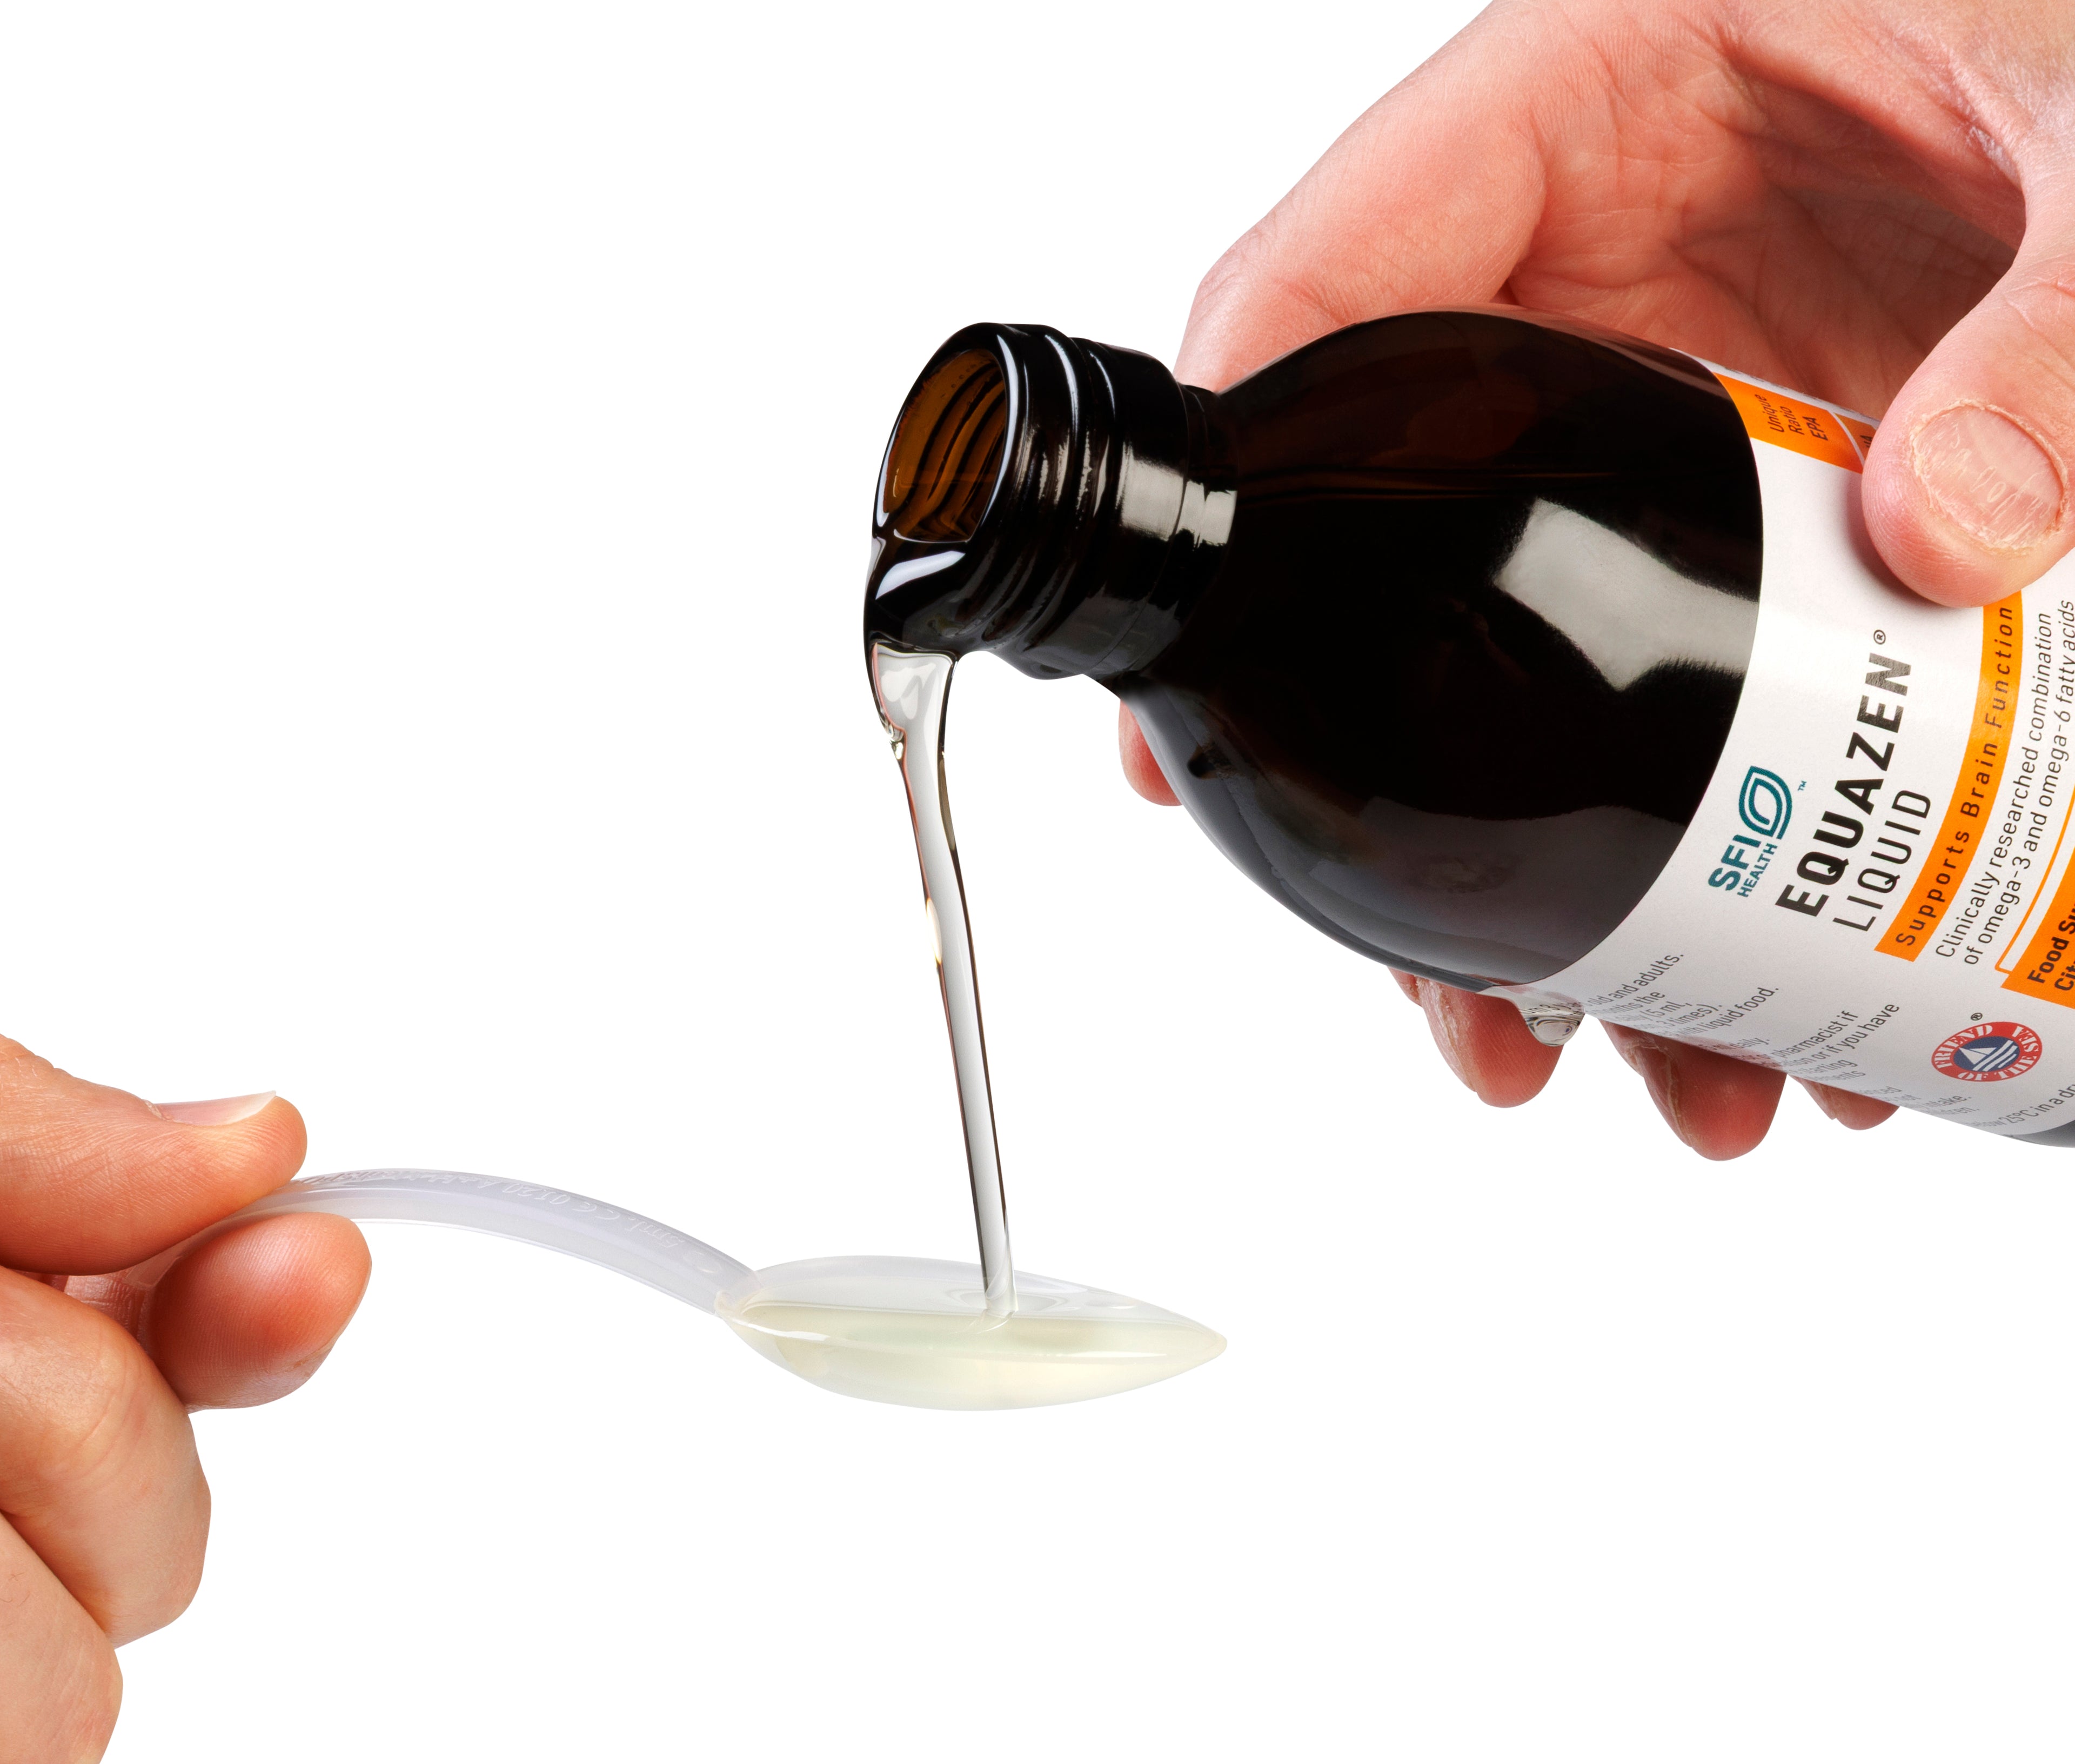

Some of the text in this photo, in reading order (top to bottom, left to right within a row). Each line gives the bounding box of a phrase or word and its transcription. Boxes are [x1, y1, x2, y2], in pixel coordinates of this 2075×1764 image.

[1755, 394, 1785, 433] Unique
[1779, 406, 1805, 435] Ratio
[1802, 416, 1828, 441] EPA
[1895, 606, 2013, 946] Supports Brain Function
[1936, 613, 2052, 957] Clinically researched combination
[1964, 600, 2075, 965] of omega-3 and omega-6 fatty acids
[1708, 834, 1762, 891] SFI
[1737, 843, 1778, 897] HEALTH
[1832, 790, 1931, 932] LIQUID
[1608, 984, 1639, 999] and
[1633, 954, 1684, 986] adults.
[2027, 937, 2070, 984] Food
[1633, 992, 1665, 1004] the
[1666, 1004, 1723, 1025] times).
[1702, 1009, 1745, 1032] liquid
[1734, 987, 1779, 1011] food.
[1770, 1010, 1859, 1058] pharmacist if
[1811, 1051, 1831, 1060] or
[1822, 1044, 1843, 1054] if
[1837, 1031, 1869, 1050] you
[1857, 1004, 1900, 1031] have
[1934, 1025, 2039, 1081] FRIEND OF THE SEA
[2030, 1103, 2055, 1113] in
[2058, 1084, 2075, 1098] dr
